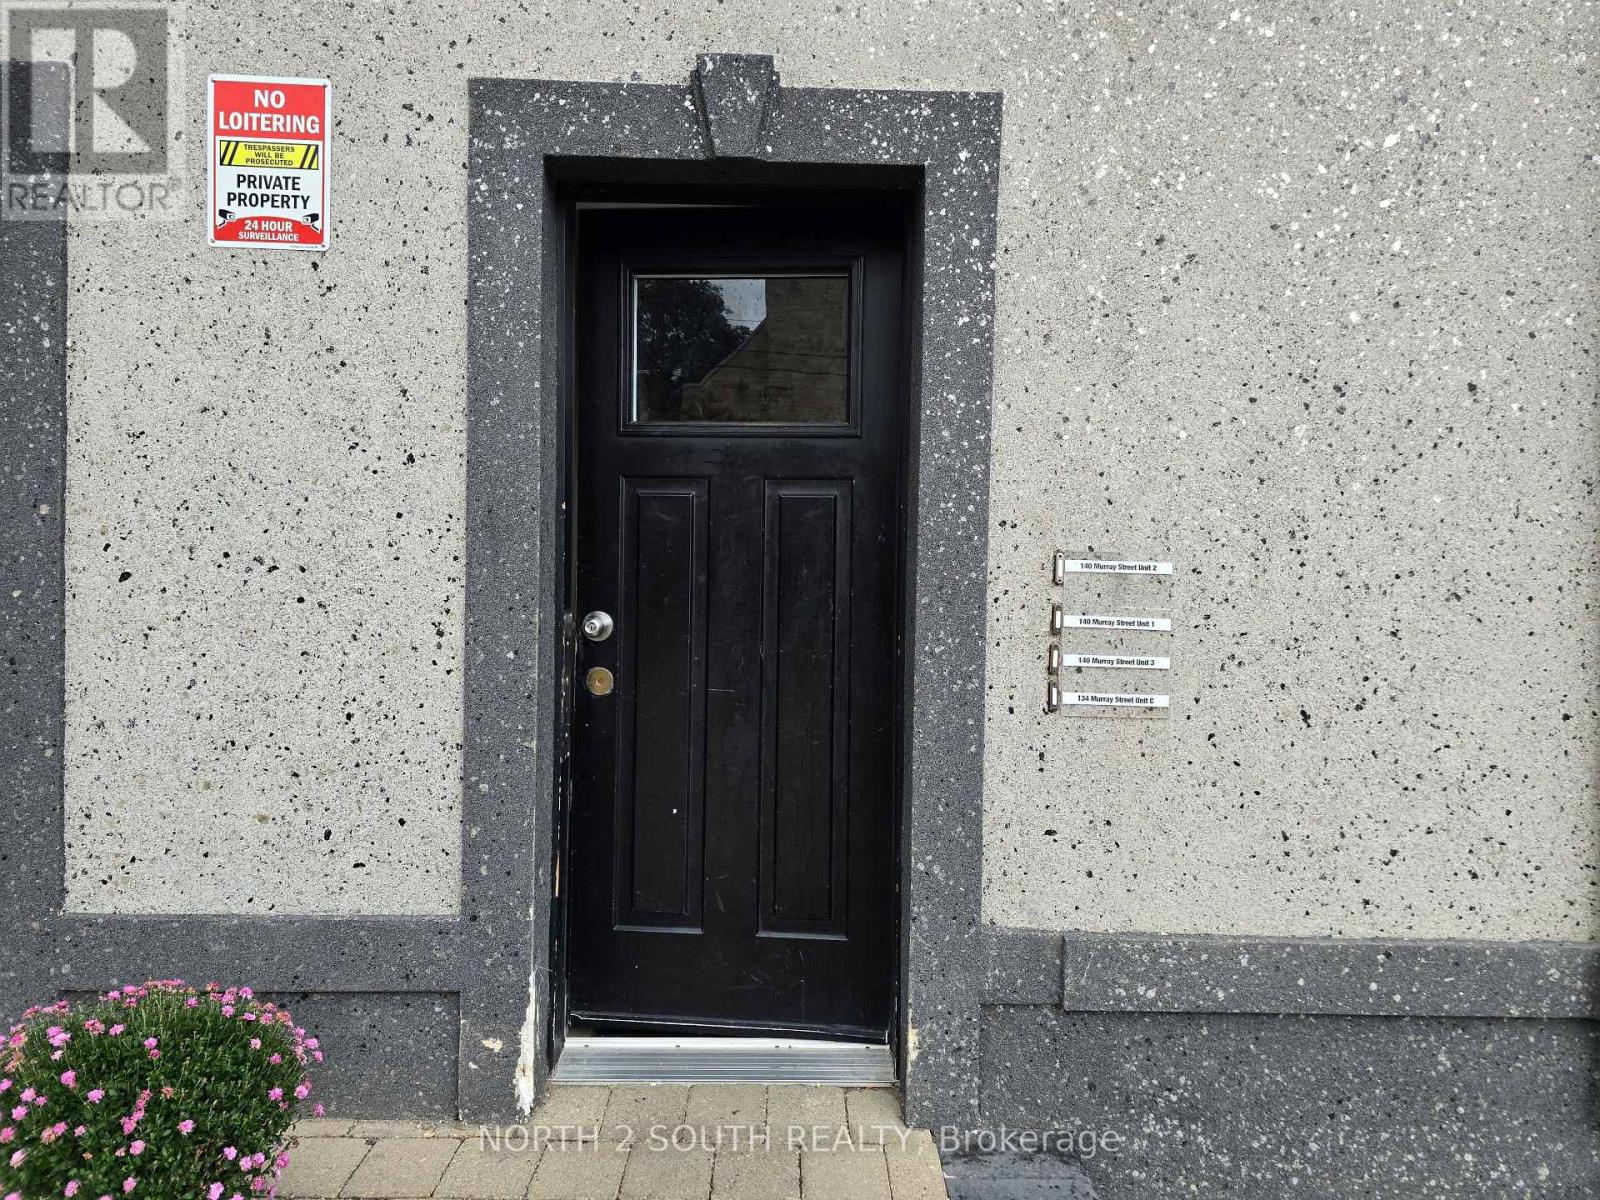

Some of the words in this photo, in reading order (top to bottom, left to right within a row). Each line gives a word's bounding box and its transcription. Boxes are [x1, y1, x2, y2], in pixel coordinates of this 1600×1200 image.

[254, 89, 286, 109] NO
[219, 111, 320, 134] LOITERING
[244, 144, 295, 152] TRESPASSERS
[255, 151, 272, 159] WILL
[246, 158, 294, 166] PROSECUTED
[236, 174, 301, 191] PRIVATE
[227, 192, 311, 210] PROPERTY
[244, 219, 258, 231] 24
[261, 220, 293, 232] HOUR
[238, 231, 299, 242] SURVEILLANCE
[1092, 619, 1115, 627] Murray
[1092, 658, 1114, 666] Murray
[1091, 696, 1114, 704] Murray
